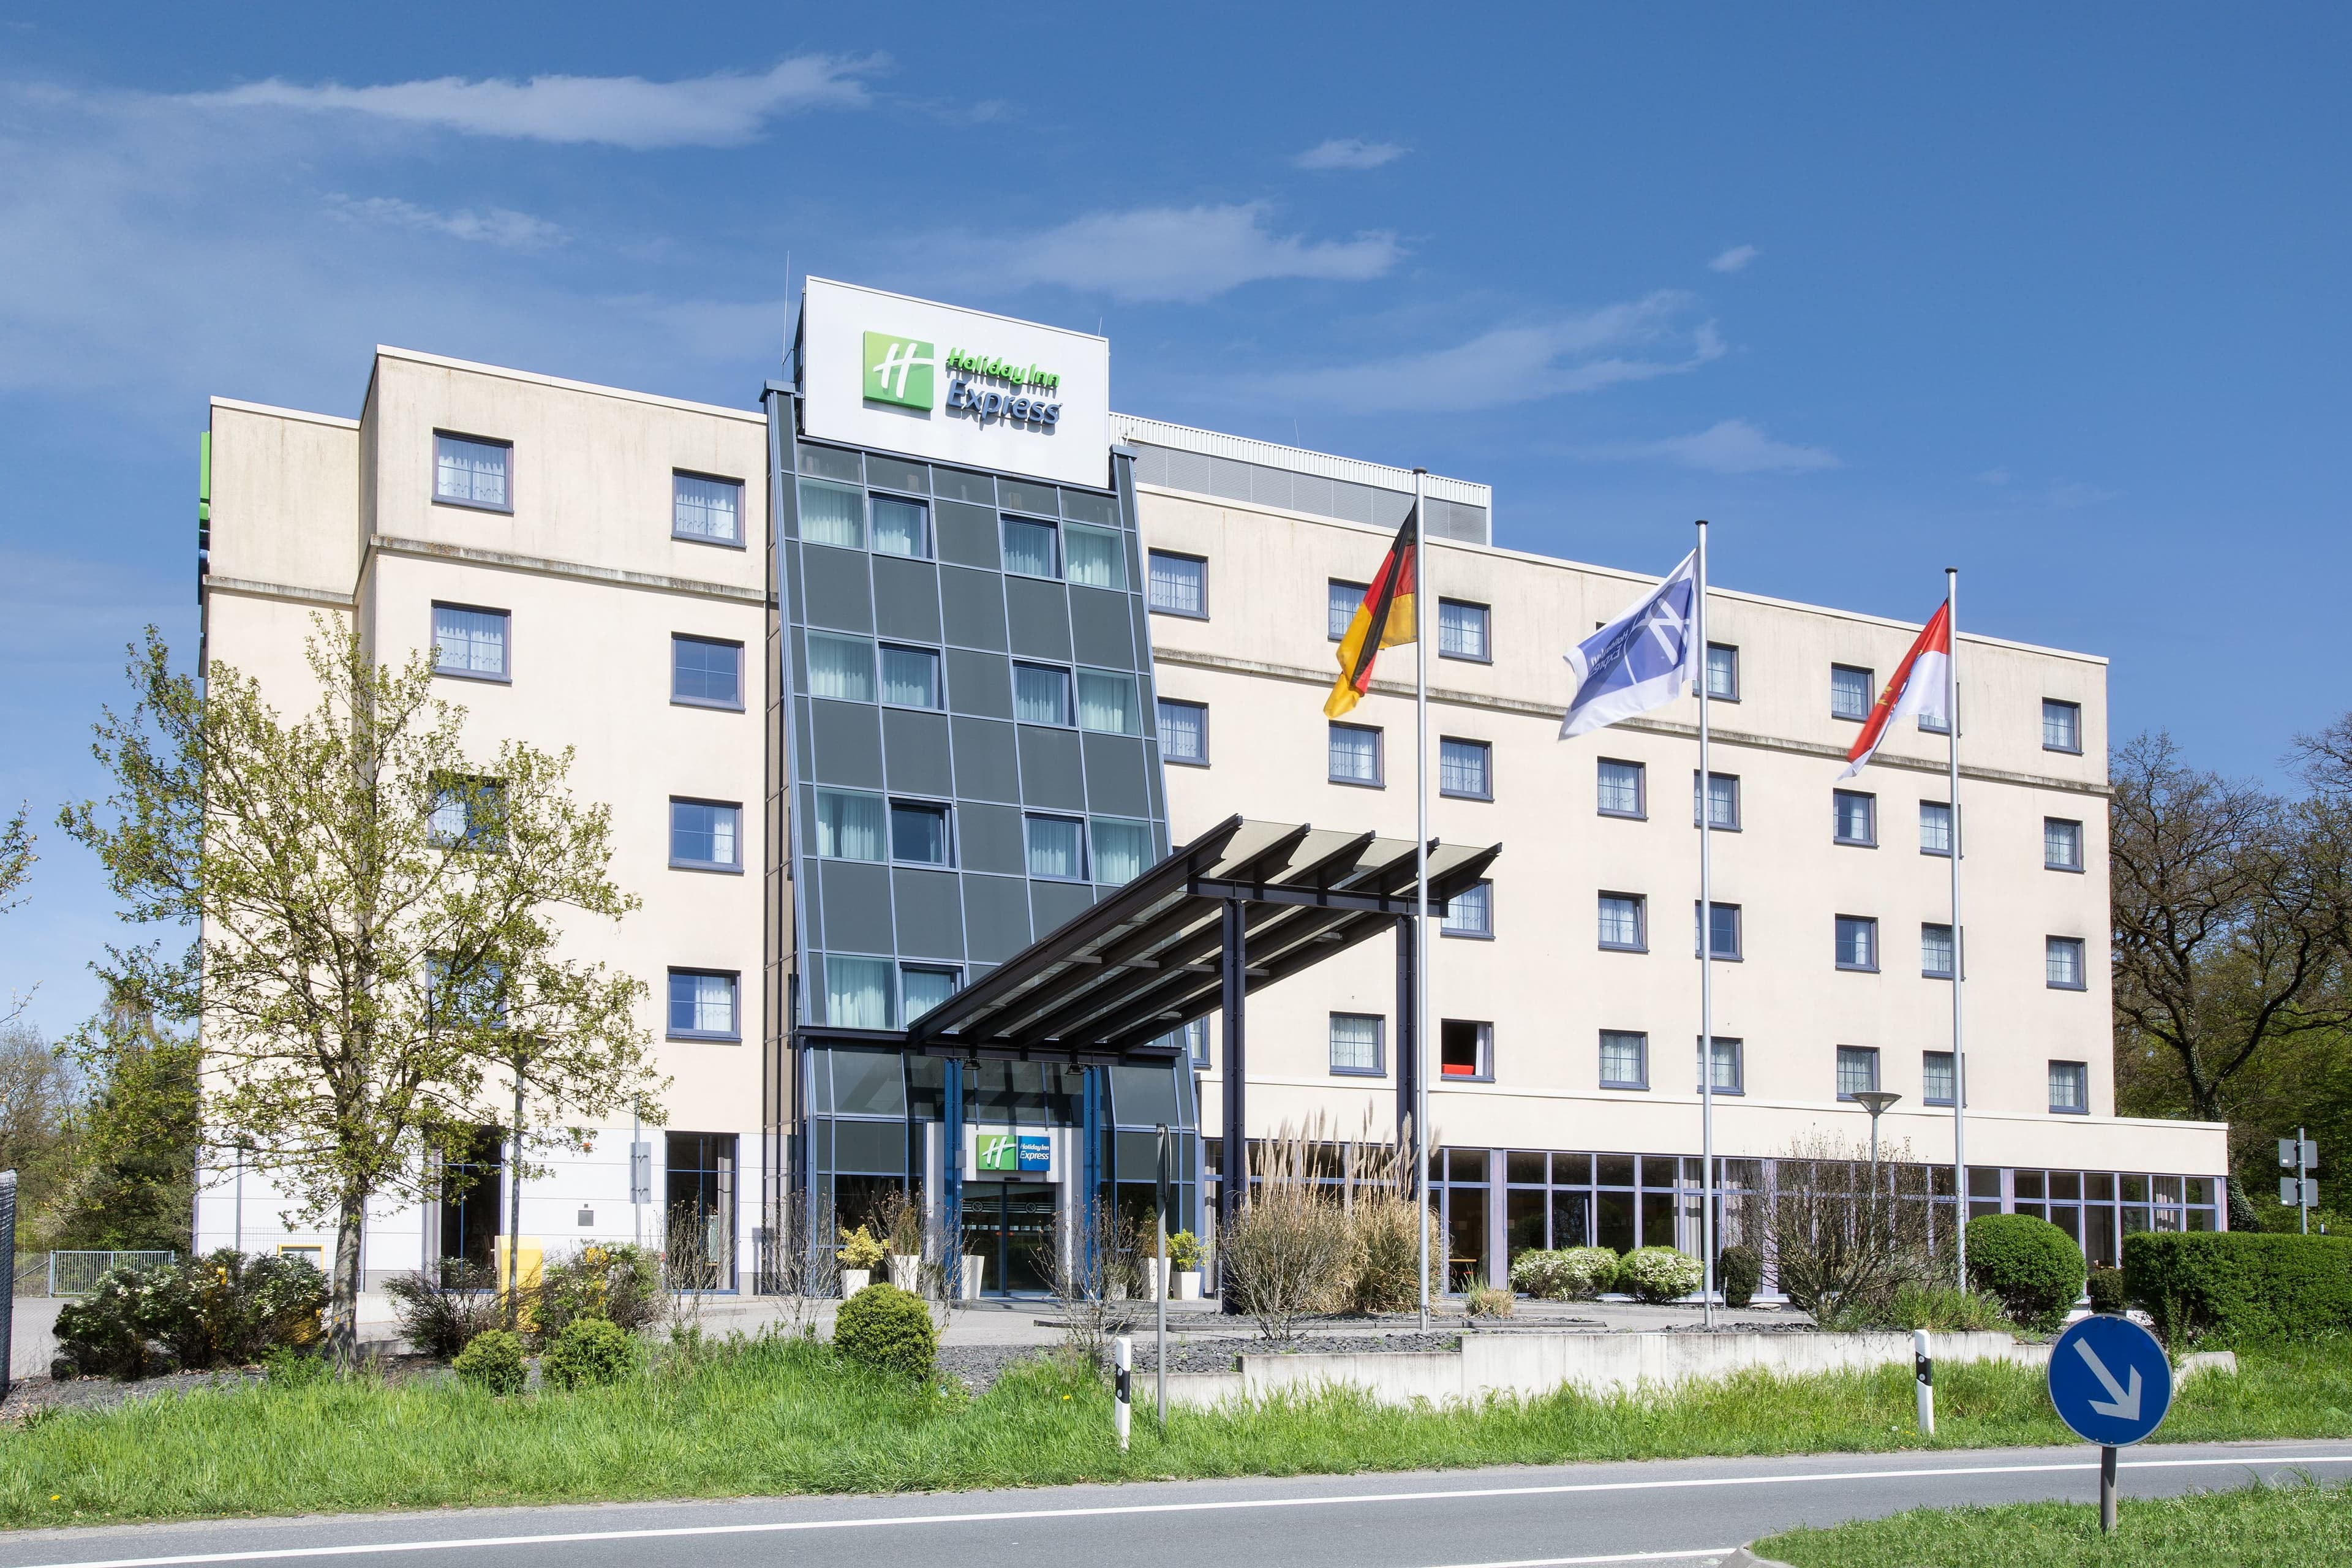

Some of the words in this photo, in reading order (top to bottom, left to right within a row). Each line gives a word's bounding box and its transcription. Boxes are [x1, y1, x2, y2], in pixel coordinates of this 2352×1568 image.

[873, 343, 934, 399] H
[947, 347, 1027, 385] Holiday
[1027, 363, 1061, 387] Inn
[947, 379, 1061, 425] Express
[982, 1136, 1017, 1168] H
[1020, 1143, 1041, 1152] Holiday
[1020, 1150, 1049, 1161] Express
